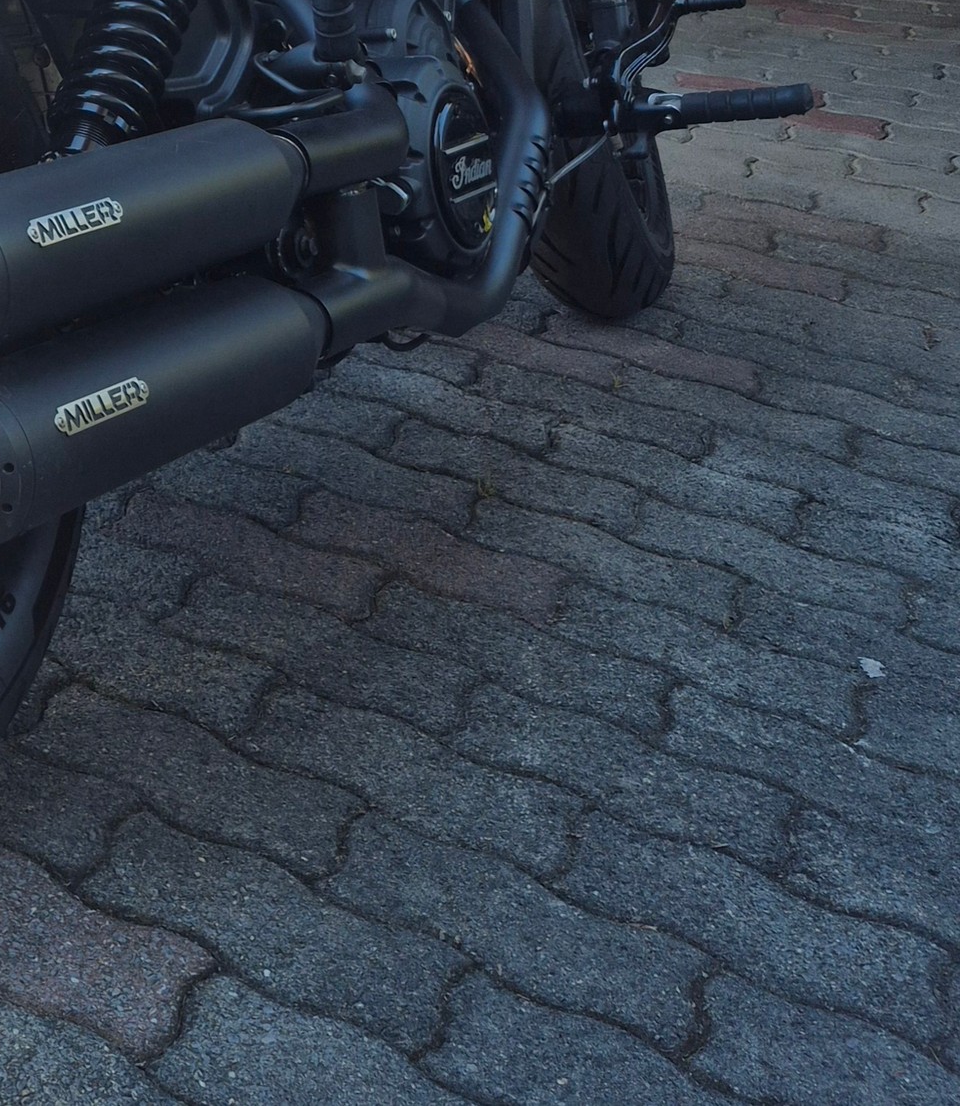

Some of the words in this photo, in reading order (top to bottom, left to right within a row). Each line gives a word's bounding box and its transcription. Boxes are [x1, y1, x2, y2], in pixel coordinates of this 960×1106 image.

[451, 156, 492, 190] Indian
[36, 200, 119, 244] MILLER
[63, 380, 145, 432] MILLER
